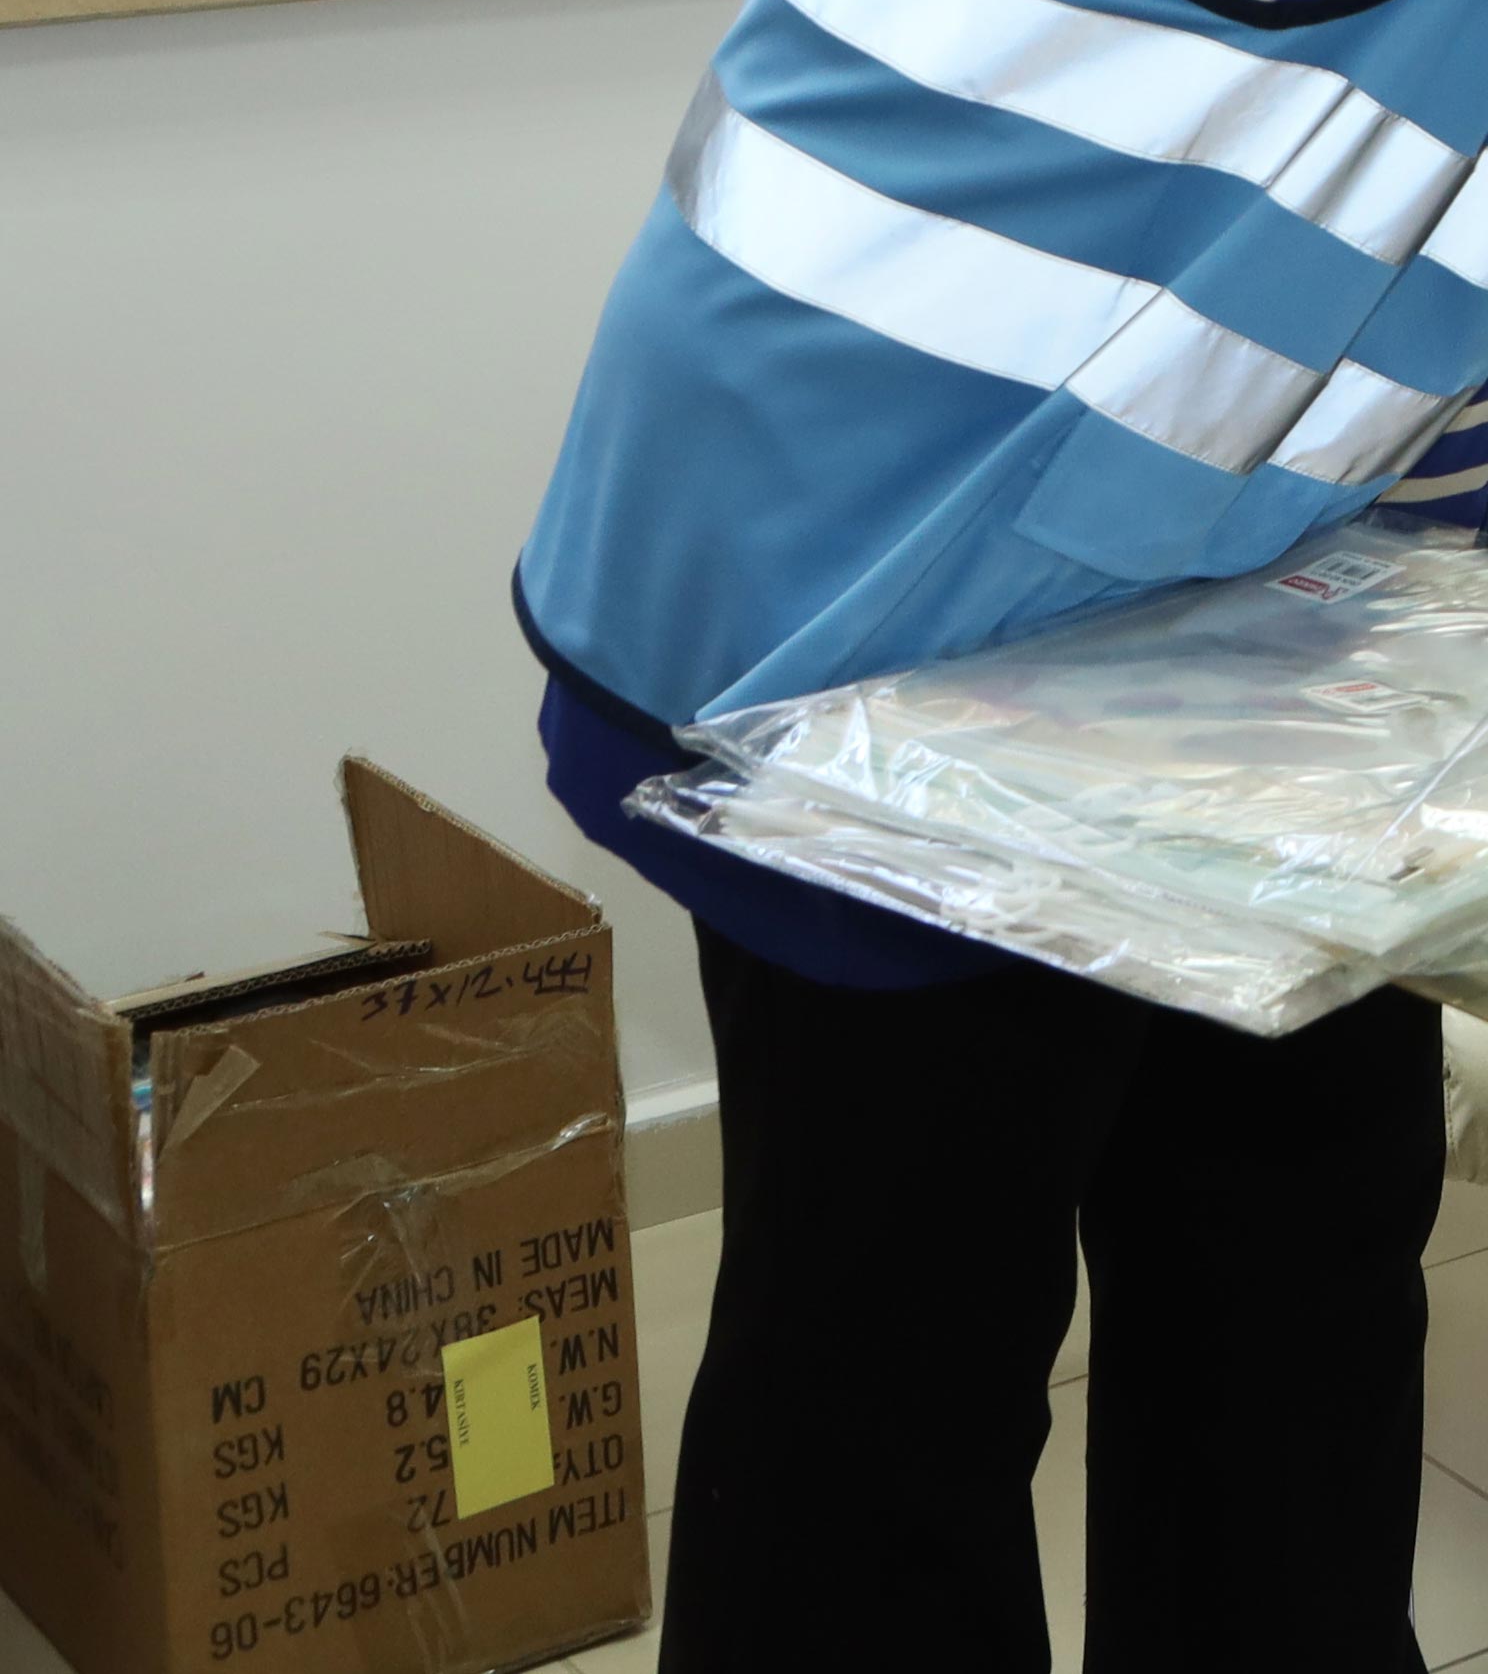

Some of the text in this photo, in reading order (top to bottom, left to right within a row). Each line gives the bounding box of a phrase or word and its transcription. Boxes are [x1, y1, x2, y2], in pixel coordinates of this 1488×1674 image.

[355, 1218, 616, 1324] MADE IN CHINA
[516, 1267, 620, 1324] MEAS:
[211, 1375, 267, 1424] CM
[212, 1323, 620, 1480] N.W. 4.8 KGS
[525, 1363, 542, 1412] KOMEK
[217, 1380, 623, 1539] G.W. 5.2 KGS
[406, 1489, 452, 1534] 72
[548, 1487, 627, 1546] ITEM
[219, 1543, 291, 1597] PCS
